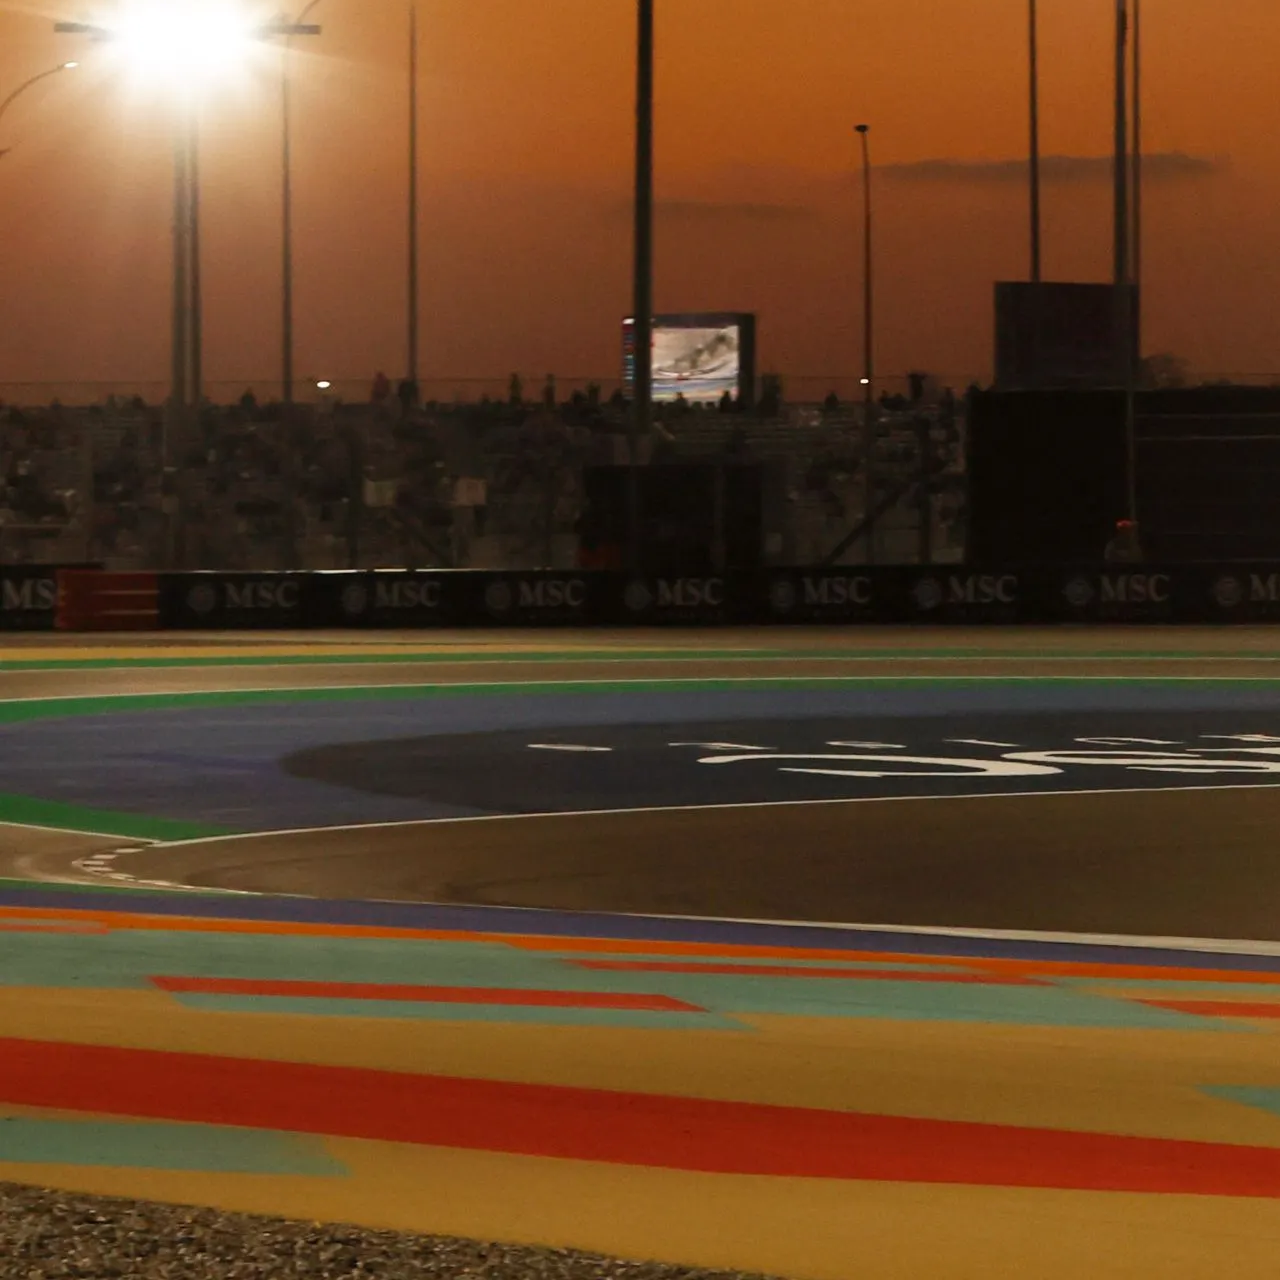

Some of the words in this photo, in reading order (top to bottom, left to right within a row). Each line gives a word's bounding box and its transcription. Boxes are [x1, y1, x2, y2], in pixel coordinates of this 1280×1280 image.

[225, 582, 298, 608] MSC
[376, 581, 440, 607] MSC
[519, 580, 584, 606] MSC
[658, 578, 722, 605] MSC
[804, 577, 870, 604] MSC
[948, 575, 1017, 603] MSC
[1101, 574, 1169, 602] MSC
